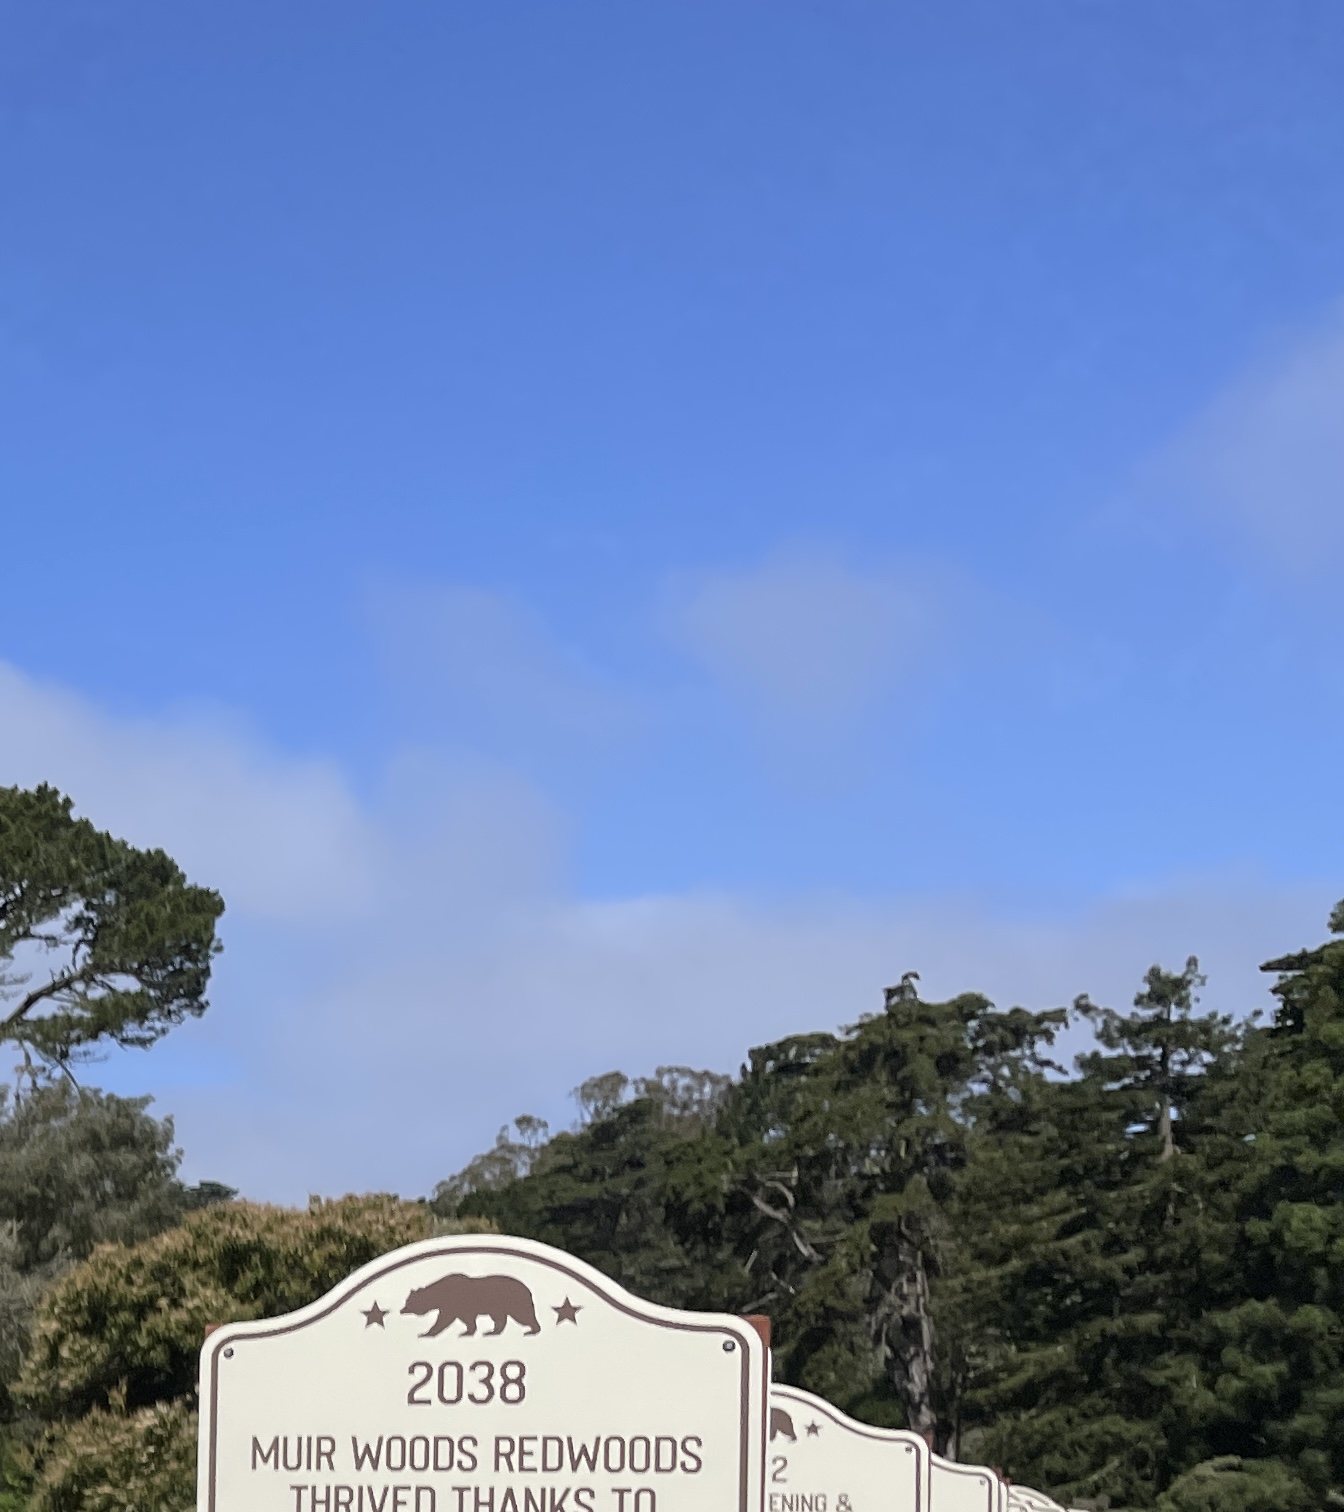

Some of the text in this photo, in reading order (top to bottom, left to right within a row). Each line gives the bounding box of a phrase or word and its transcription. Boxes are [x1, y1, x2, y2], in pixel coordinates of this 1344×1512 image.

[407, 1360, 526, 1406] 2038
[251, 1435, 703, 1474] MUIR WOODS REDWOODS
[769, 1493, 853, 1512] ENING &
